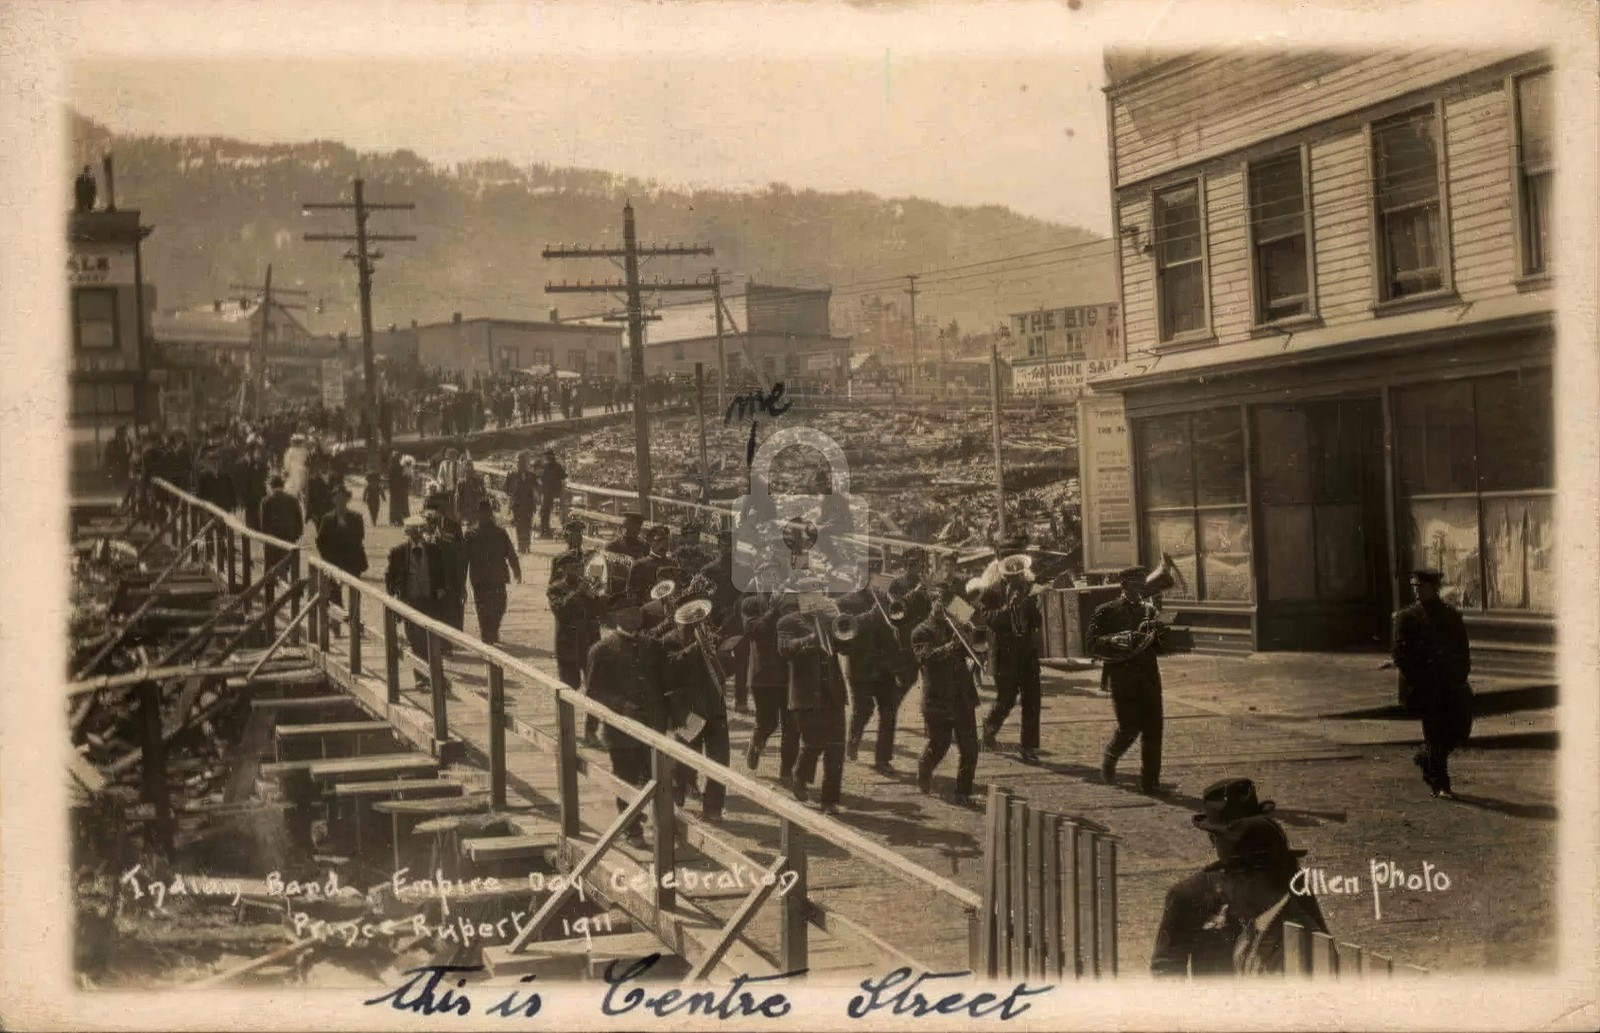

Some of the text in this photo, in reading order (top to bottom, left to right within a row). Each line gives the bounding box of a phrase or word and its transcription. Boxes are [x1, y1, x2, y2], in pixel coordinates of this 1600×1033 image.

[723, 382, 792, 425] me
[265, 869, 343, 898] Band
[392, 867, 501, 916] Empire
[528, 871, 586, 903] Day
[610, 862, 799, 897] Celebration
[1289, 858, 1451, 920] Allen Photo
[293, 911, 612, 951] Prince Rupert 1911
[485, 973, 544, 1019] is
[599, 953, 810, 1019] Centre
[847, 966, 1054, 1021] Street
